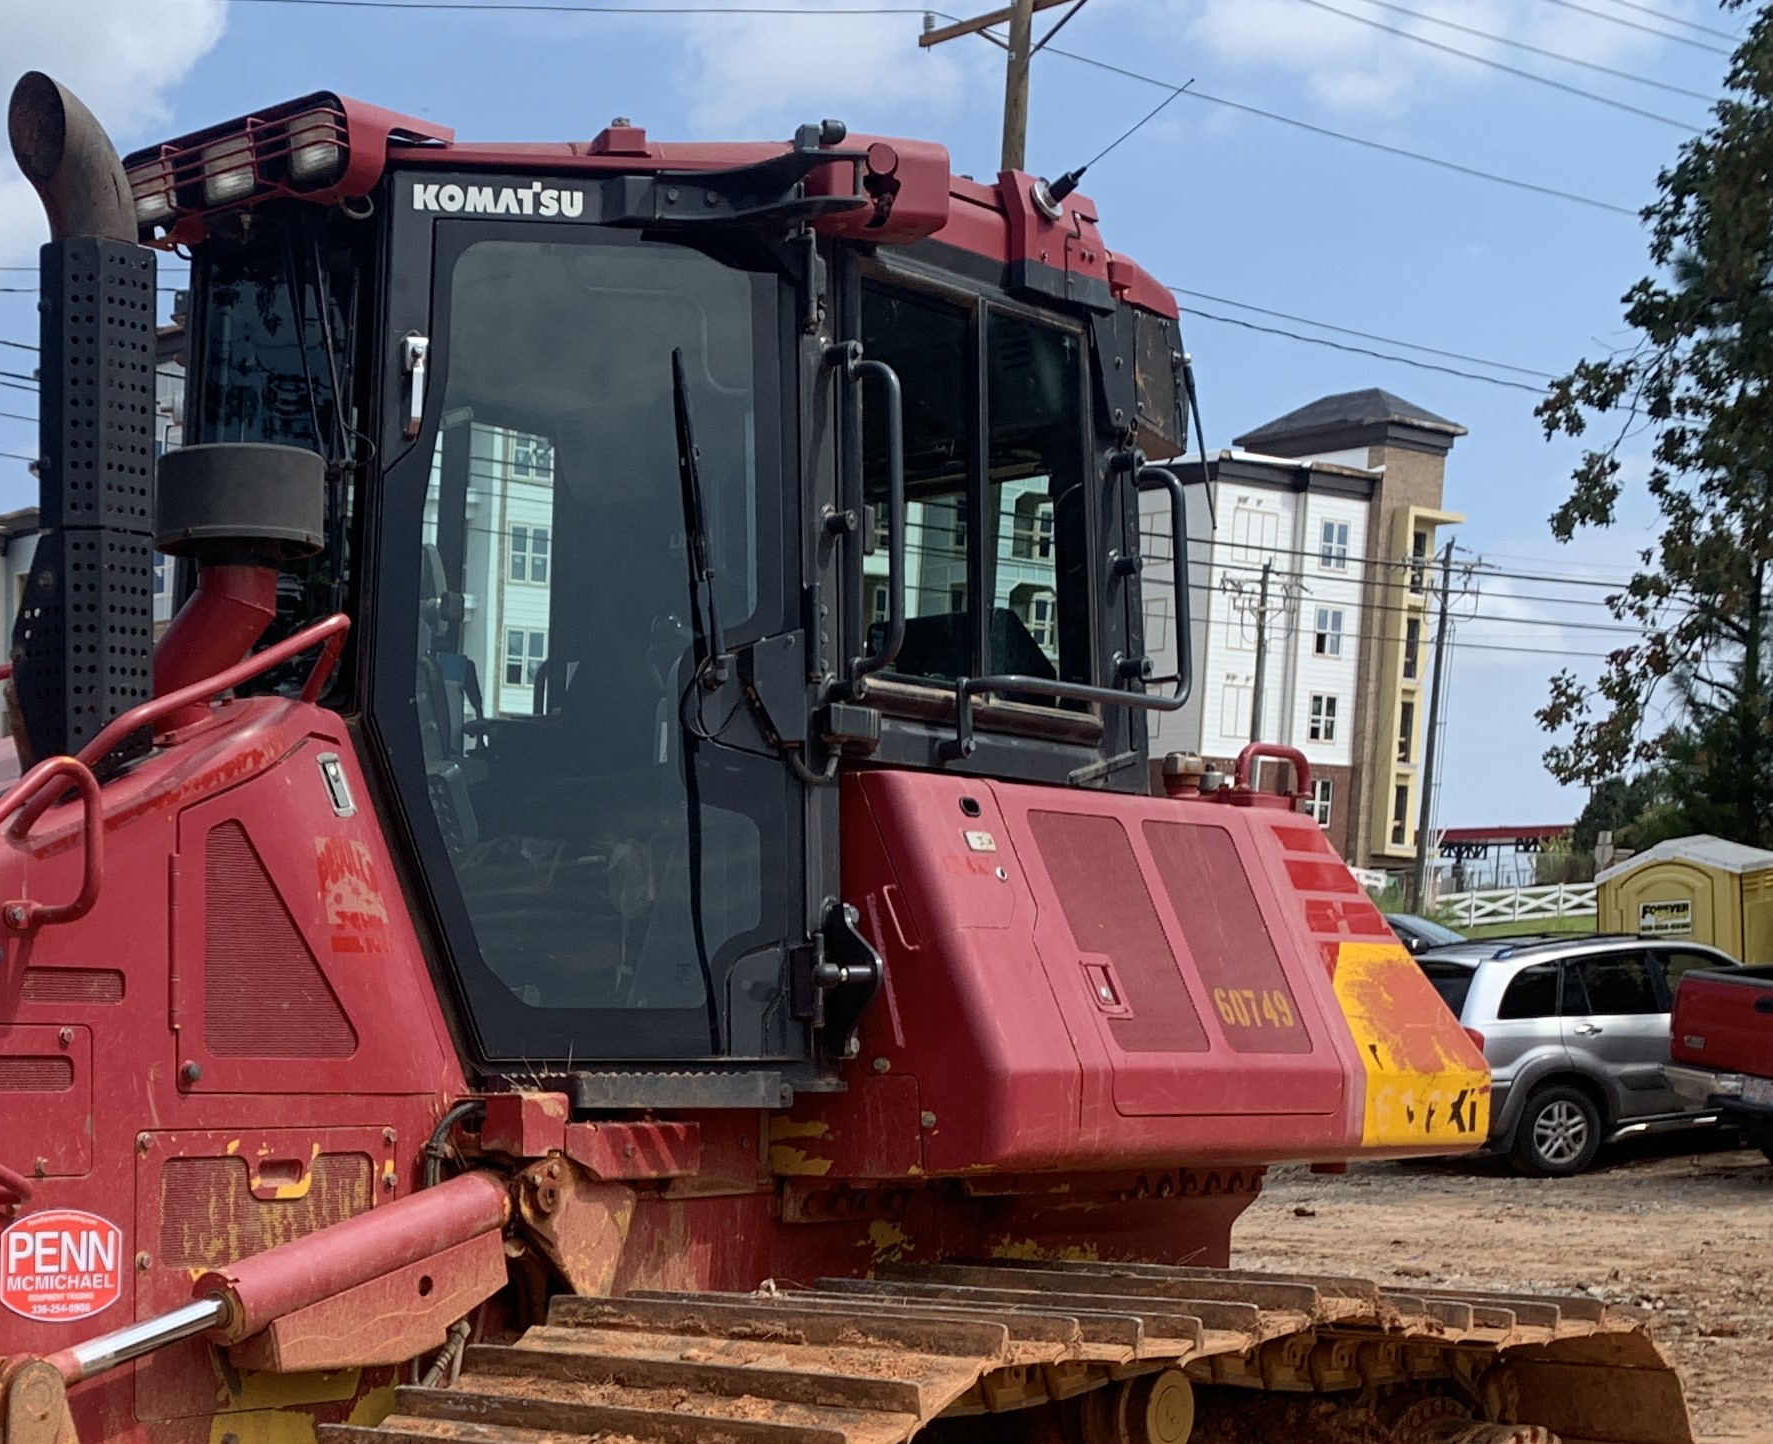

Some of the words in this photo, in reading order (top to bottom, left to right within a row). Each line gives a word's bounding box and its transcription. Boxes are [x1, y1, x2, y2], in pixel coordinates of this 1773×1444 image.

[412, 181, 584, 218] KOMATSU
[1213, 987, 1294, 1028] 60749
[8, 1230, 115, 1274] PENN
[6, 1273, 115, 1291] MCMICHAEL
